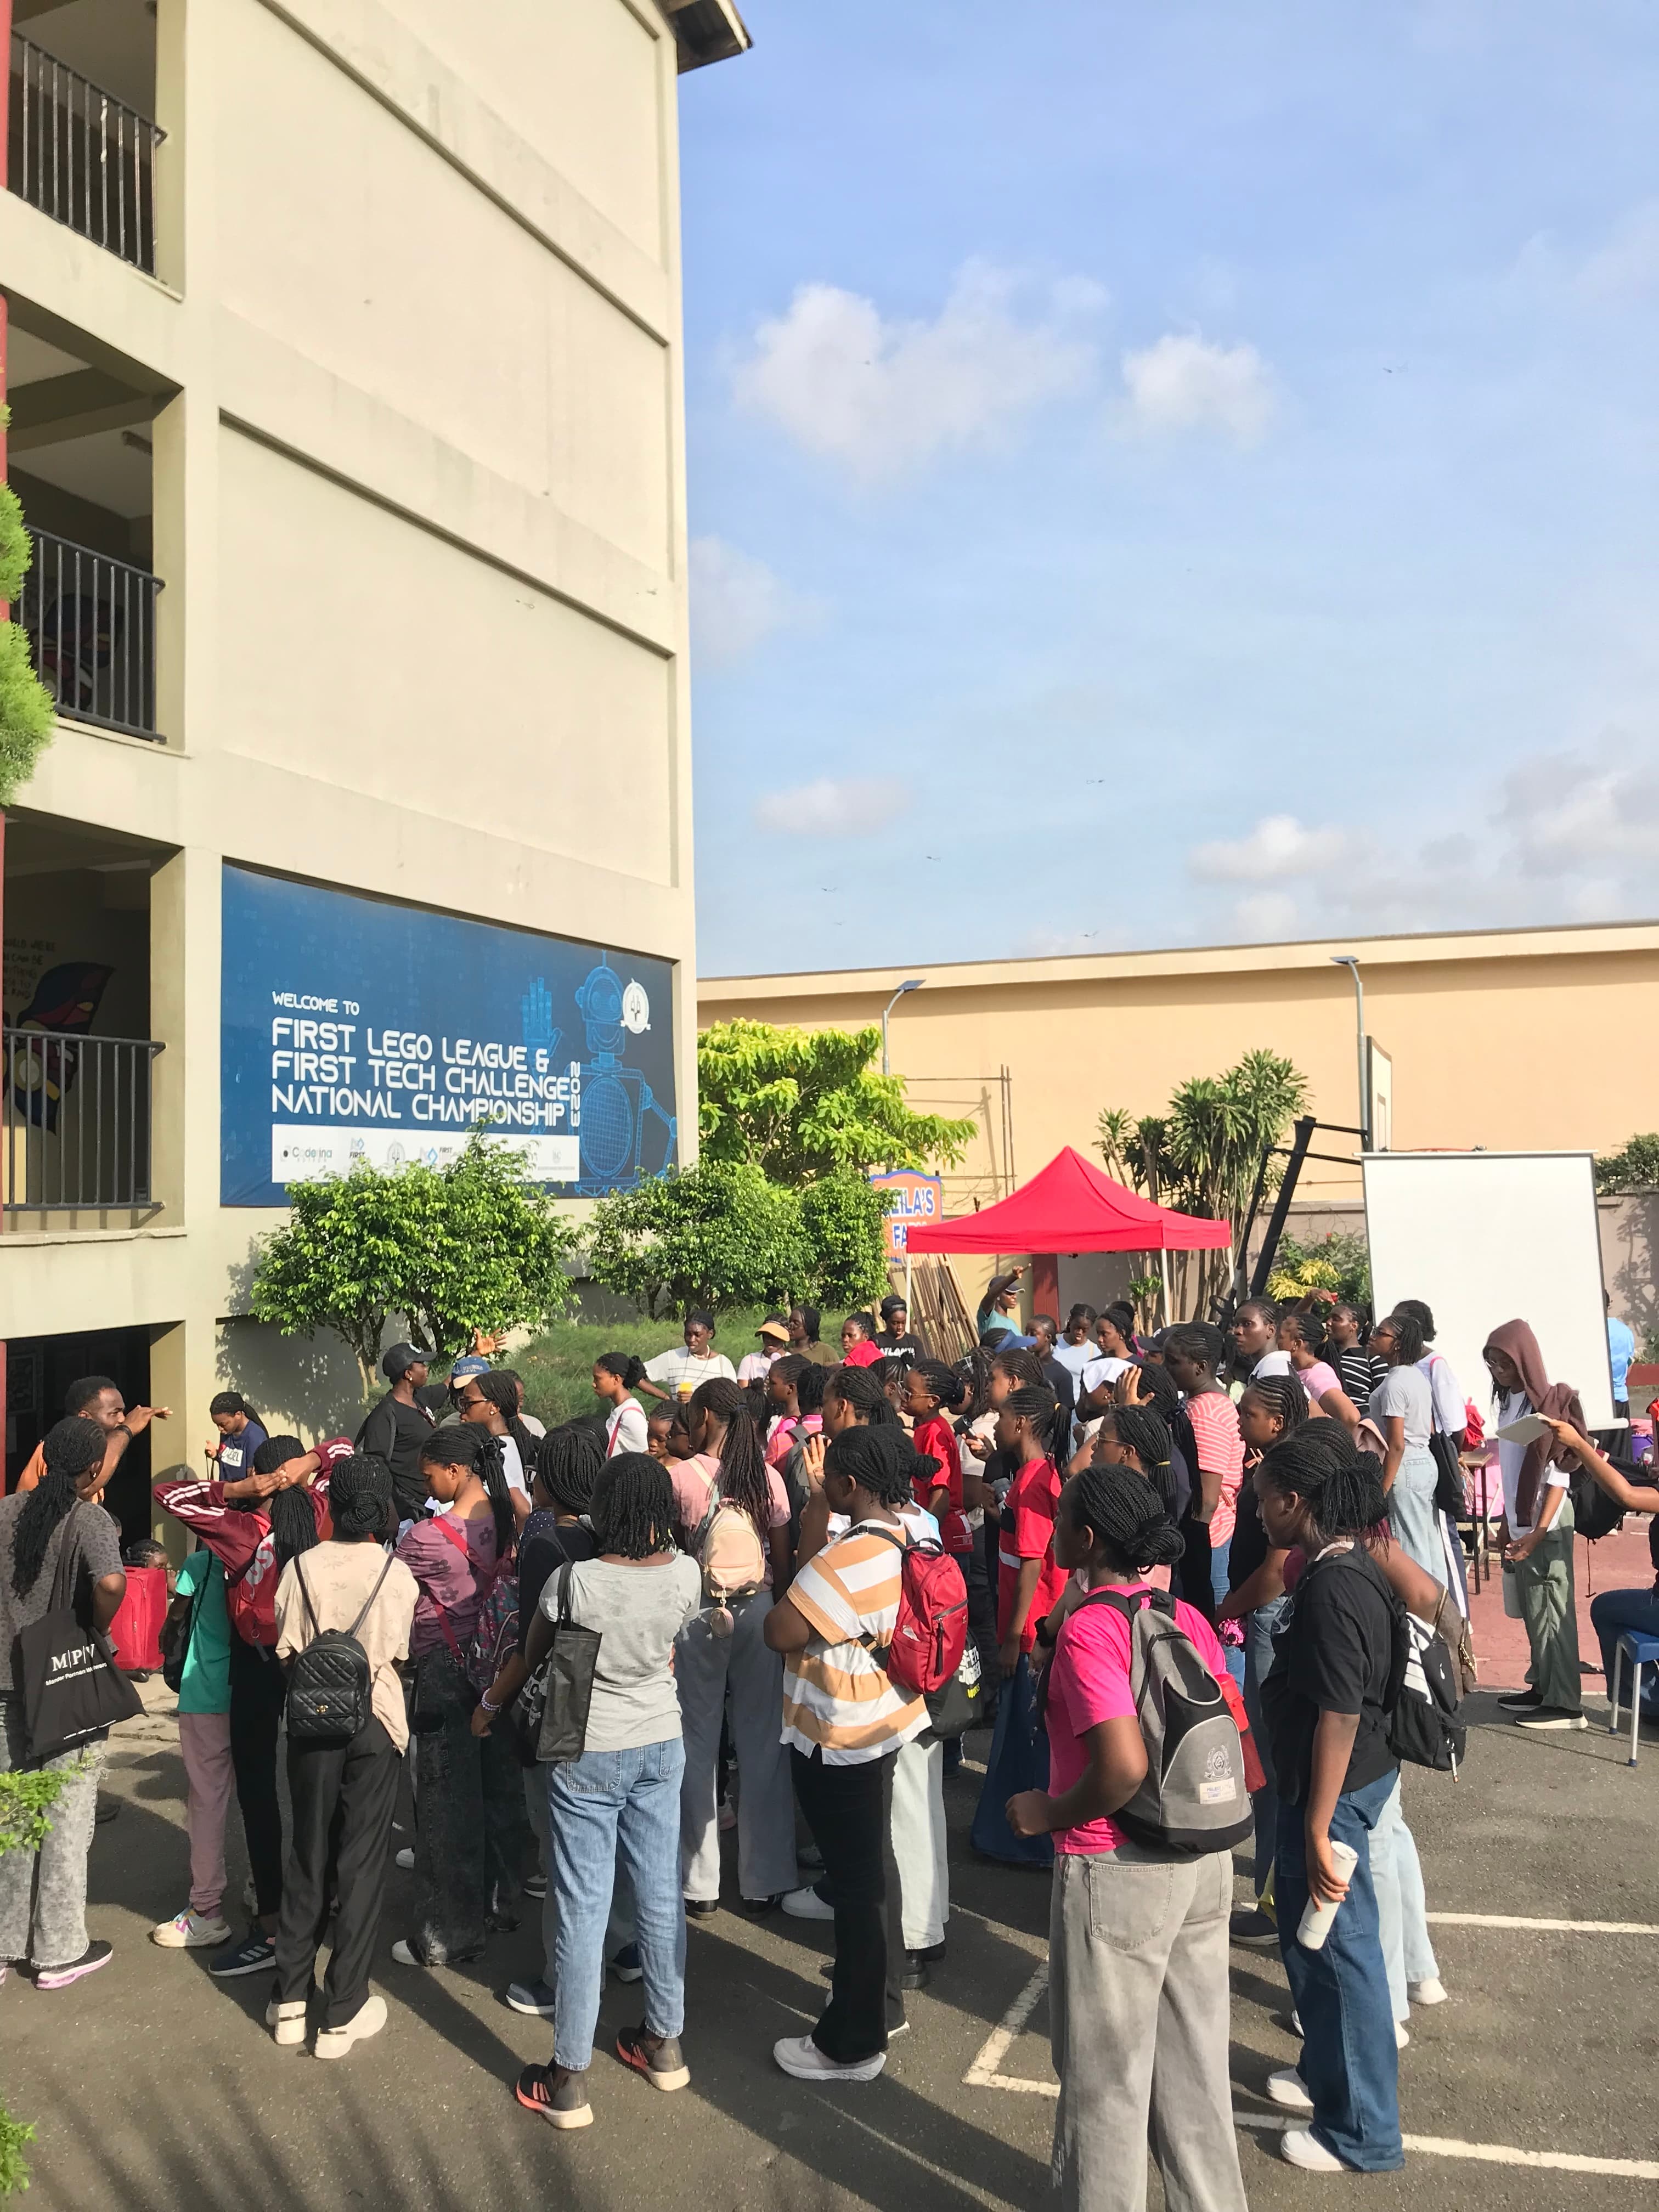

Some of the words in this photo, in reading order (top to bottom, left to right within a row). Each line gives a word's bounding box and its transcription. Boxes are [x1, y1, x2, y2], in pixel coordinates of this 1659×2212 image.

[272, 991, 338, 1013] WELCOME
[342, 1001, 360, 1015] TO
[272, 1017, 356, 1053] FIRST
[367, 1028, 432, 1061] LEGO
[442, 1037, 527, 1071] LEAGUE
[535, 1048, 549, 1073] &
[272, 1050, 356, 1085] FIRST
[368, 1058, 436, 1092] TECH
[445, 1066, 570, 1101] CHALLENGE
[571, 1061, 580, 1127] 2023
[272, 1083, 402, 1119] NATIONAL
[412, 1093, 565, 1127] CHAMPIONSHIP
